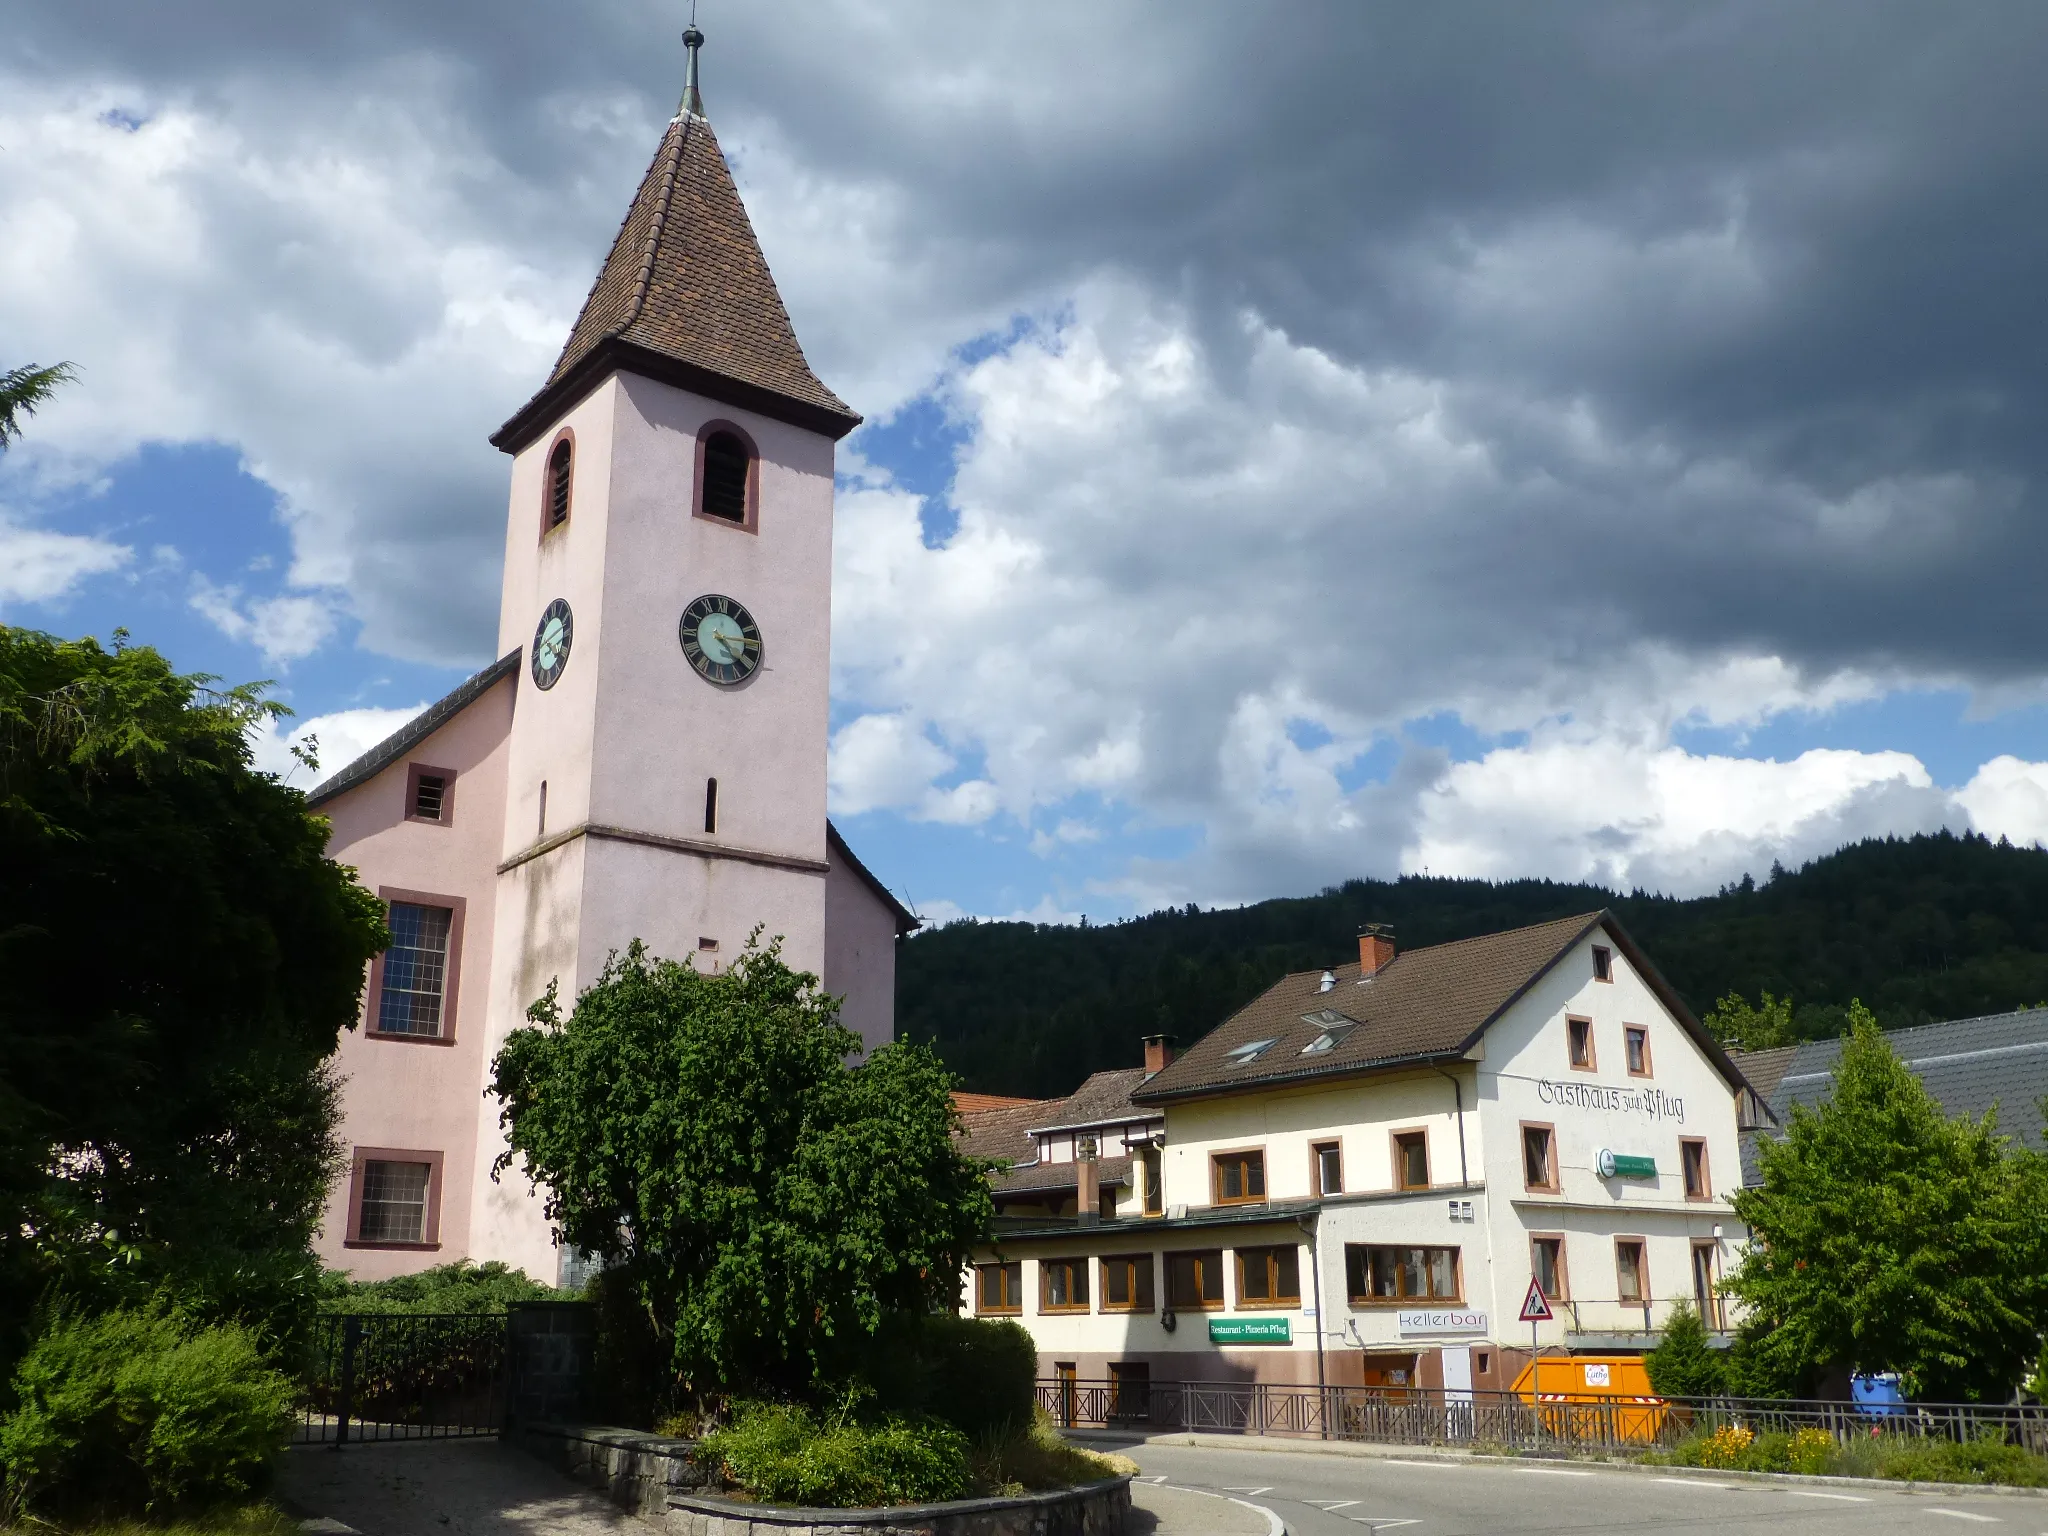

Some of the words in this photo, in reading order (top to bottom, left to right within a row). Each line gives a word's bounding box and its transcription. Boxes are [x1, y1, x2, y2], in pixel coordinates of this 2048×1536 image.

[701, 598, 714, 614] XI
[687, 608, 702, 624] X
[1538, 1078, 1620, 1112] Gasthaus
[1622, 1095, 1643, 1112] zum
[1643, 1088, 1685, 1125] Pflug
[1400, 1312, 1485, 1327] kellerbar
[1211, 1325, 1241, 1334] Restaurant
[1245, 1324, 1269, 1334] Pizzeria
[1269, 1324, 1287, 1335] Pflug
